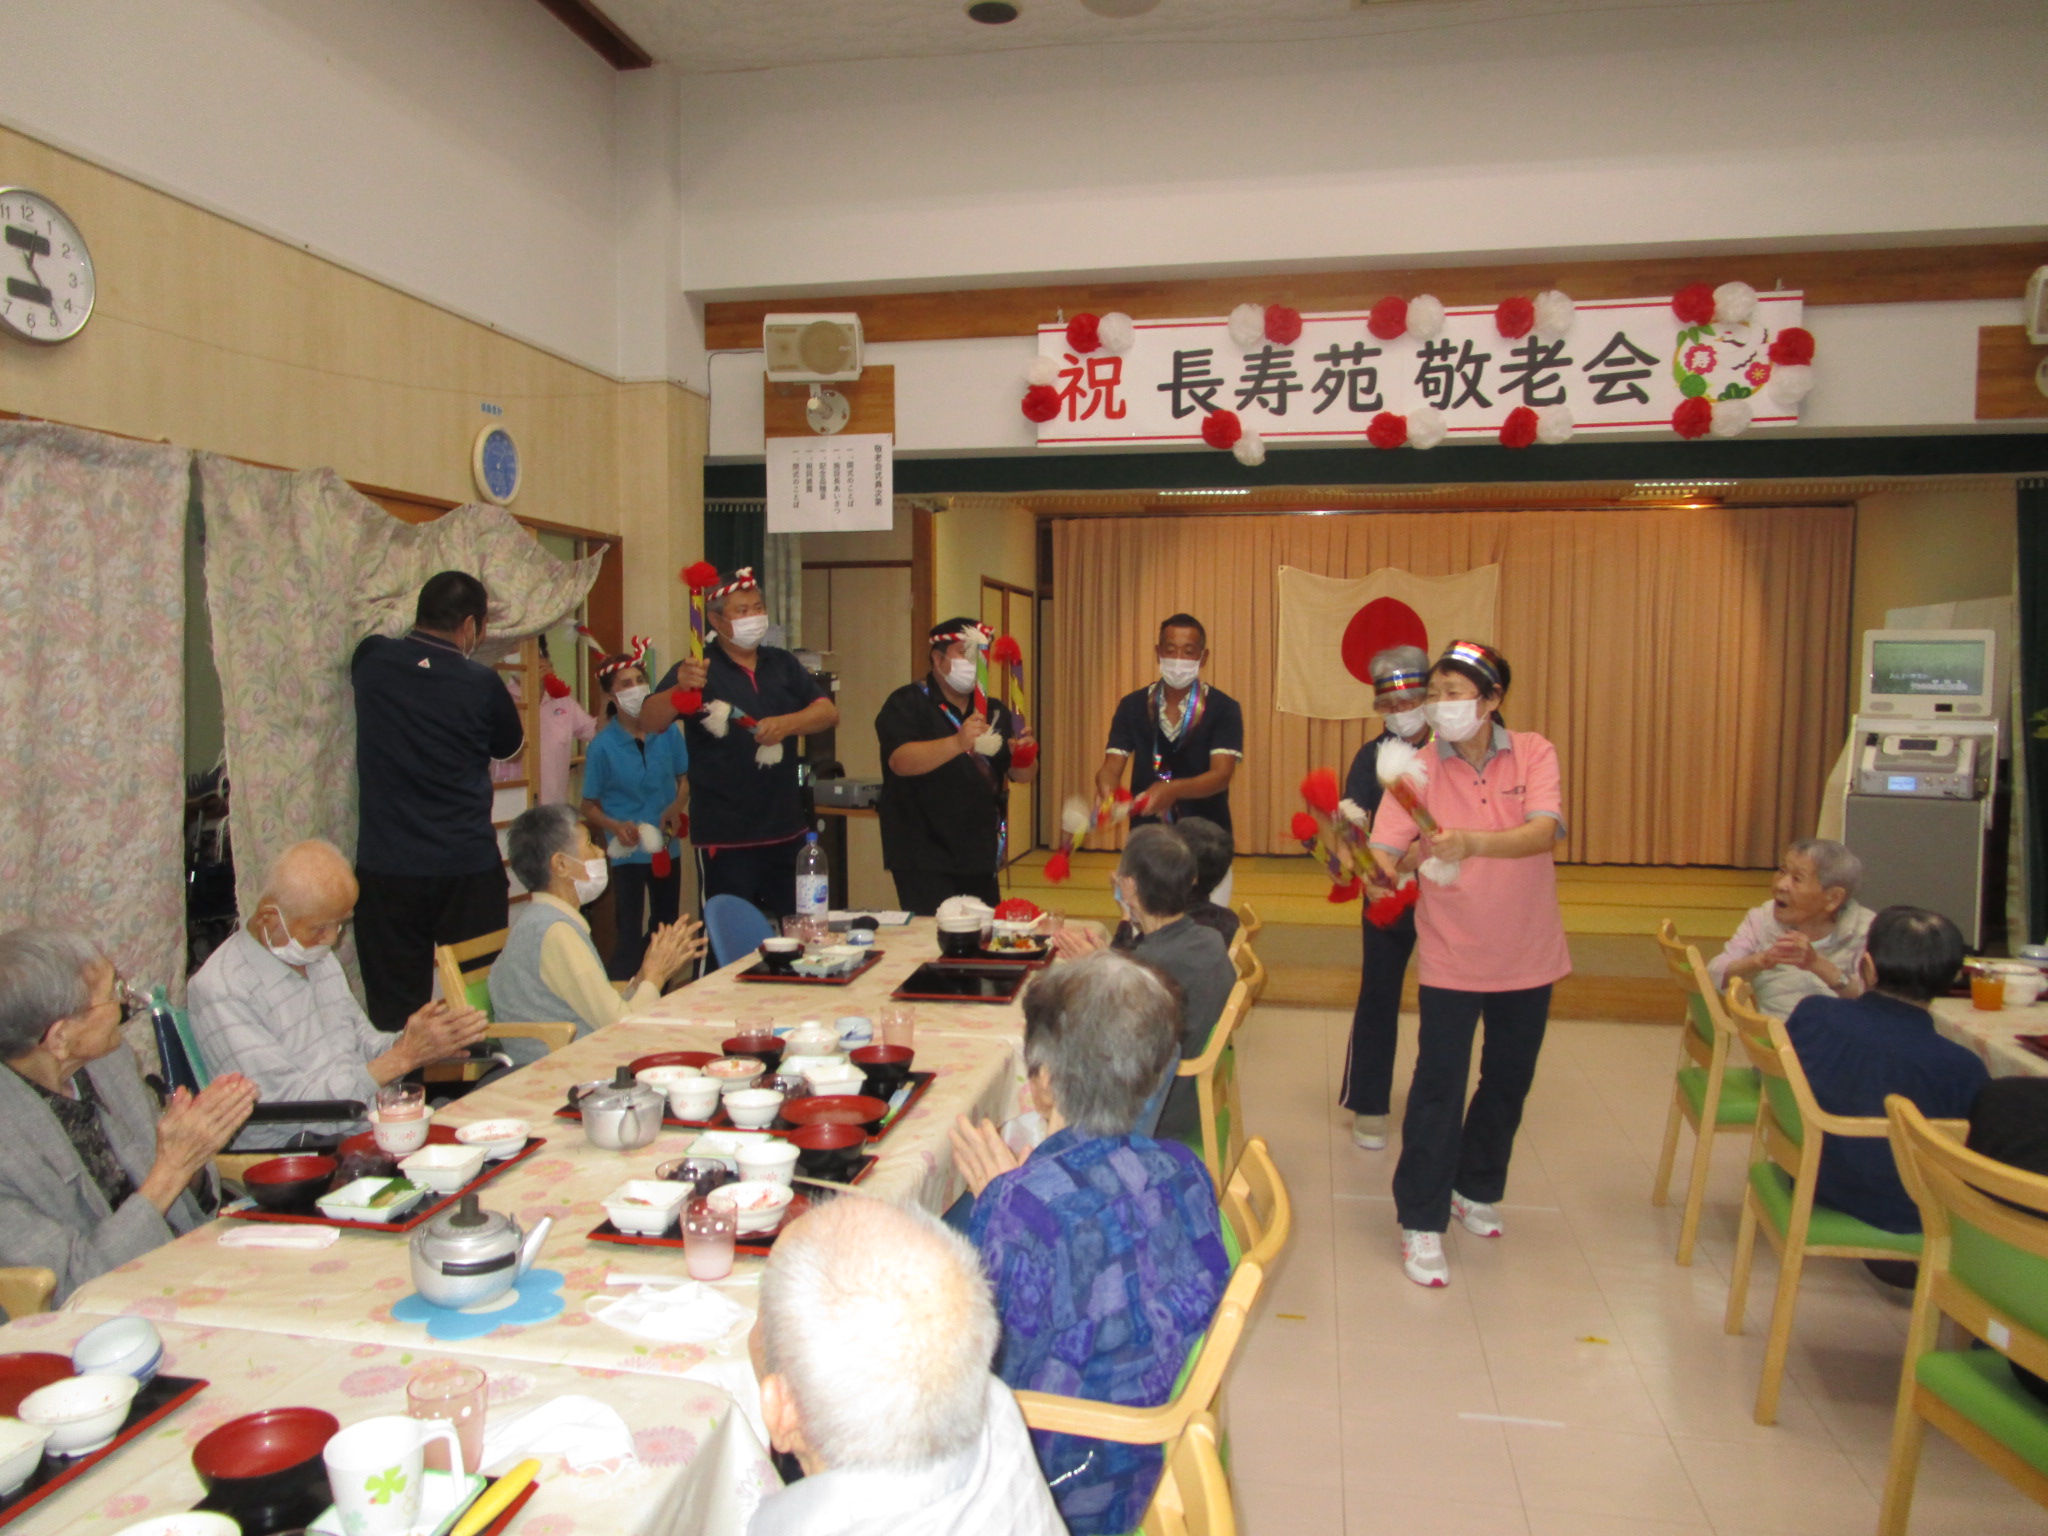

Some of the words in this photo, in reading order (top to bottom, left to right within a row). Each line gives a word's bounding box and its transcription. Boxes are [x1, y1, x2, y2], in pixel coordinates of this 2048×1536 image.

[20, 204, 34, 222] 12
[62, 243, 71, 259] 2
[68, 272, 77, 289] 3
[3, 298, 12, 315] 7
[63, 298, 72, 314] 4
[26, 312, 36, 329] 6
[49, 310, 58, 328] 5
[1058, 353, 1127, 423] 祝
[1156, 341, 1384, 420] 長寿苑
[1413, 331, 1660, 411] 敬老会
